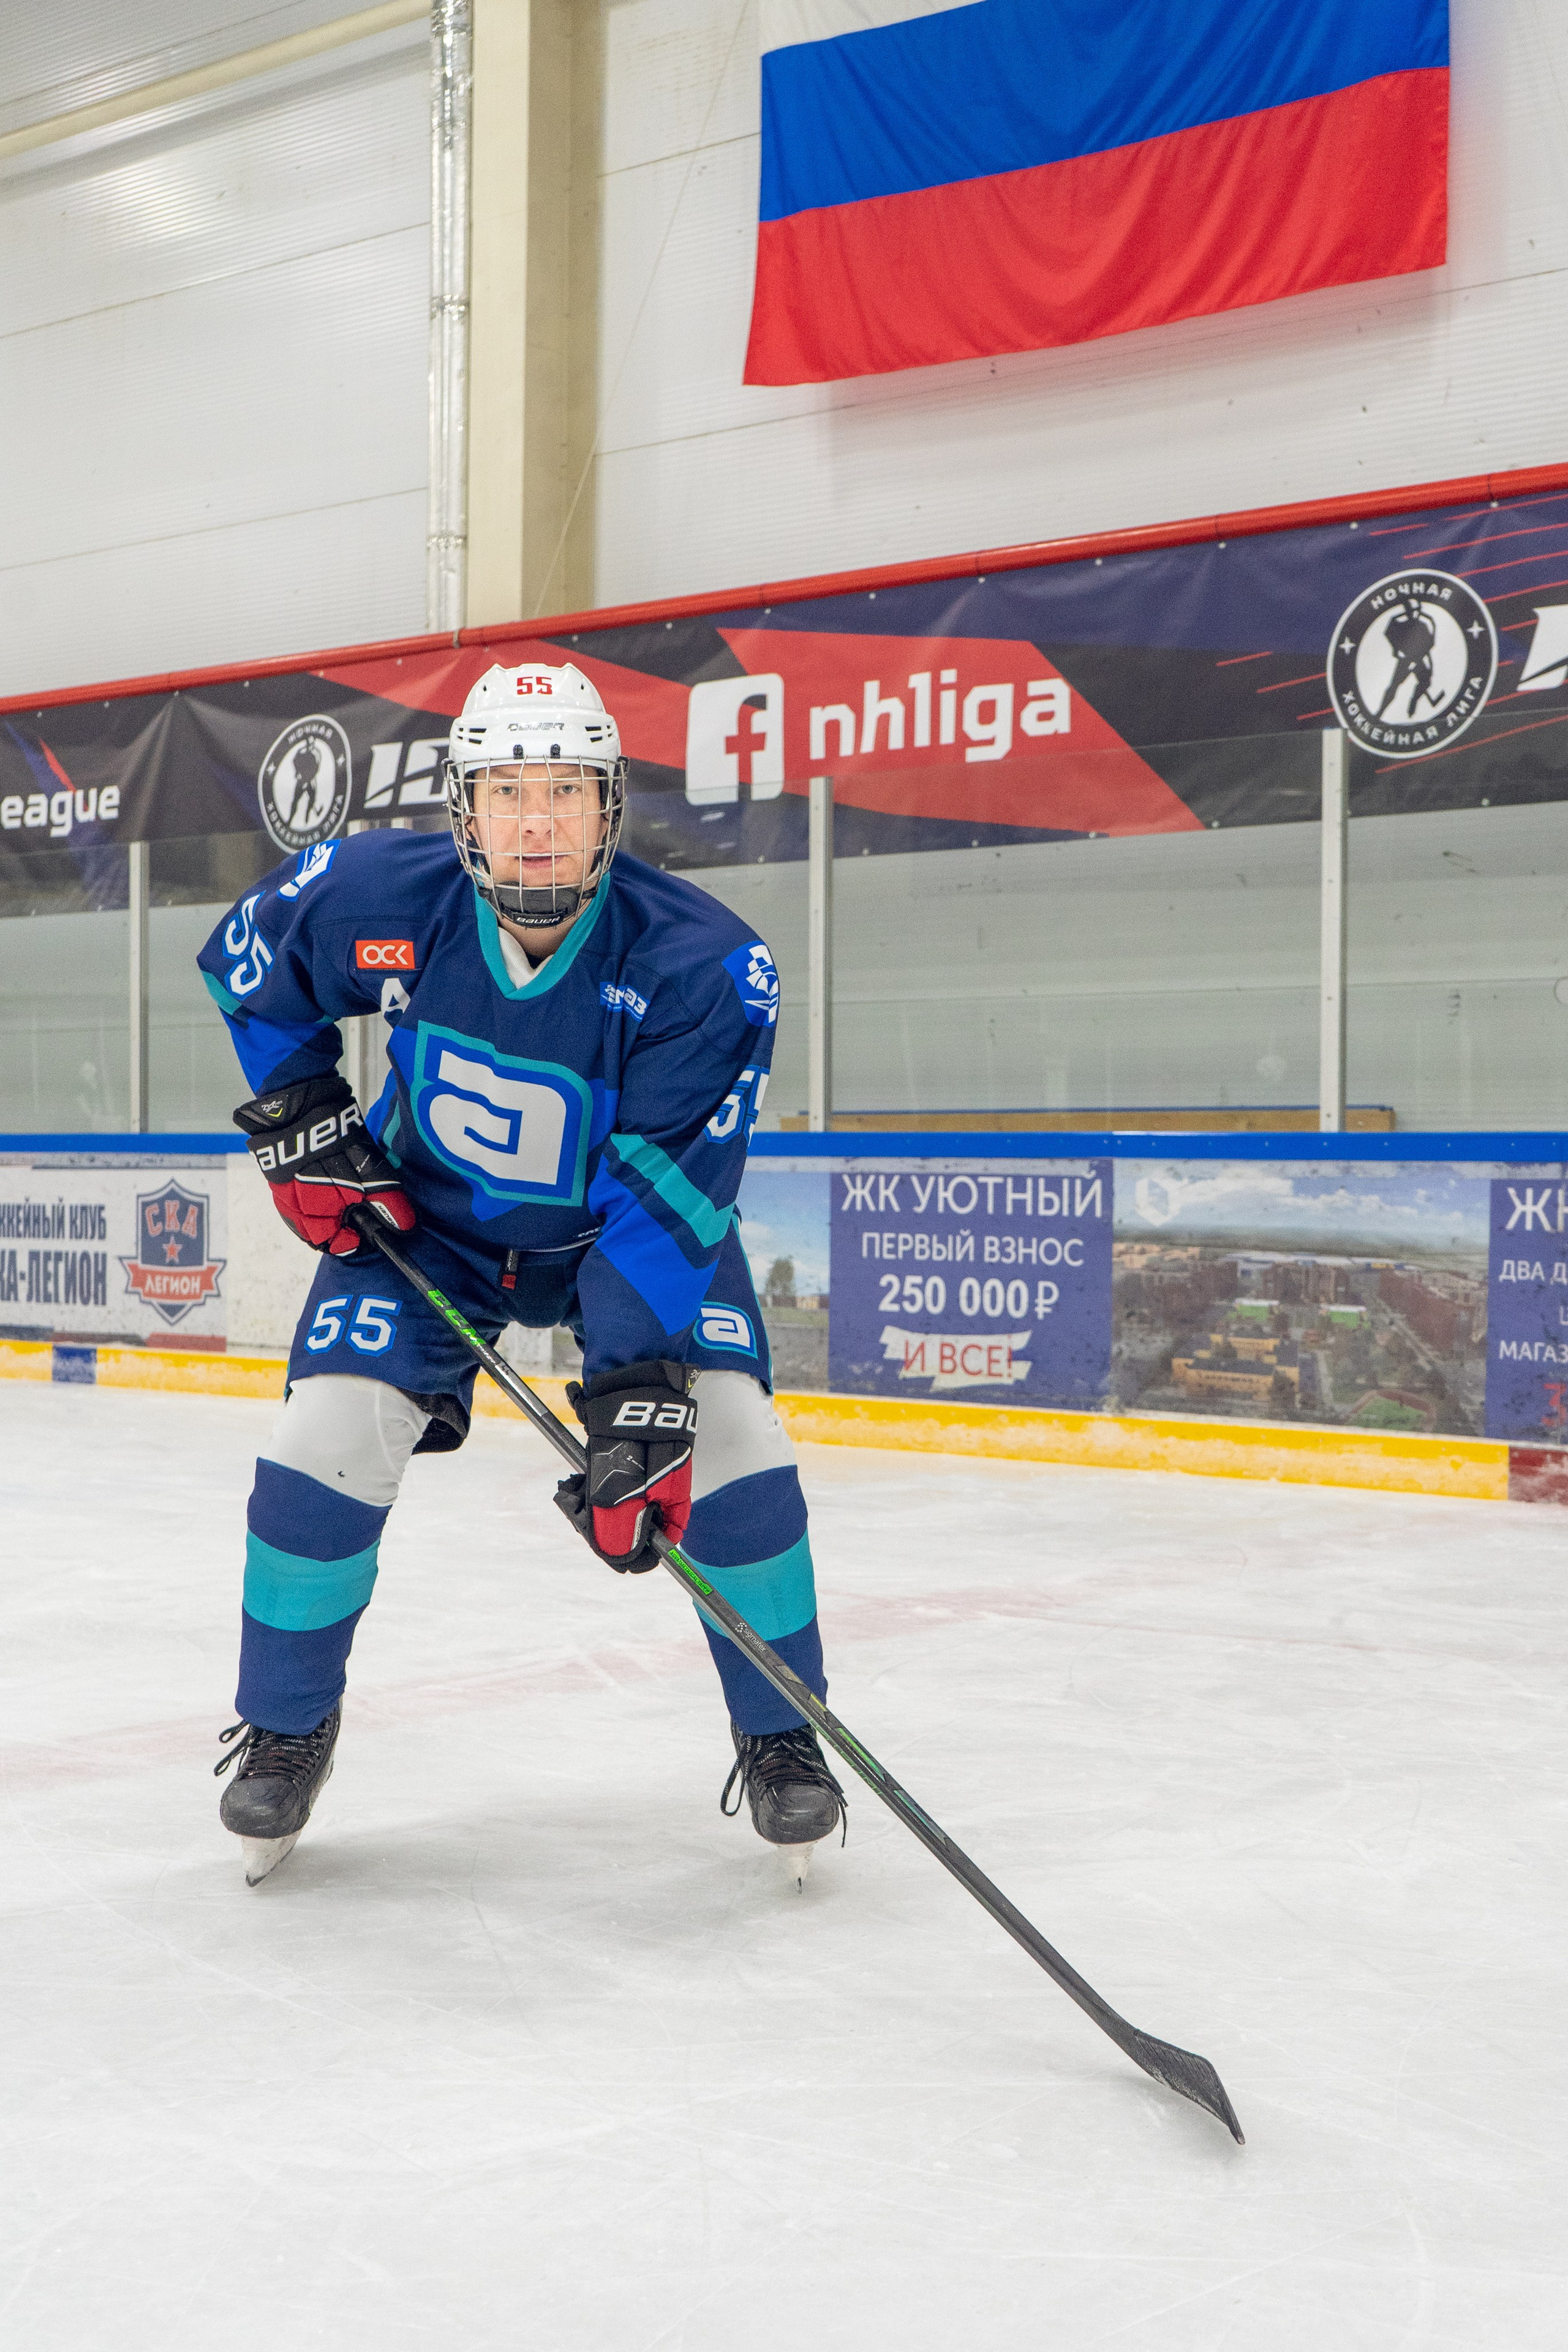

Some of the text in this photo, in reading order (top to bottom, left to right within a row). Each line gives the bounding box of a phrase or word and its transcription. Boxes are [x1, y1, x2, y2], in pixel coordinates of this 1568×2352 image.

[1371, 581, 1453, 611] НОЧНАЯ
[517, 676, 552, 695] 55
[1342, 674, 1483, 745] ХОККЕЙНАЯ ЛИГА
[223, 891, 276, 999] 55
[249, 1102, 364, 1172] AUER
[841, 1169, 1102, 1218] ЖК УЮТНЫЙ
[69, 1203, 107, 1240] КЛУБ
[145, 1199, 198, 1238] СКА
[861, 1229, 1084, 1267] ПЕРВЫЙ ВЗНОС
[145, 1274, 201, 1294] ЛЕГИОН
[1499, 1259, 1545, 1283] ДВА
[878, 1273, 946, 1315] 250
[306, 1297, 401, 1354] 55
[903, 1334, 1014, 1378] И ВСЕ!
[743, 1627, 766, 1653] sigmatex
